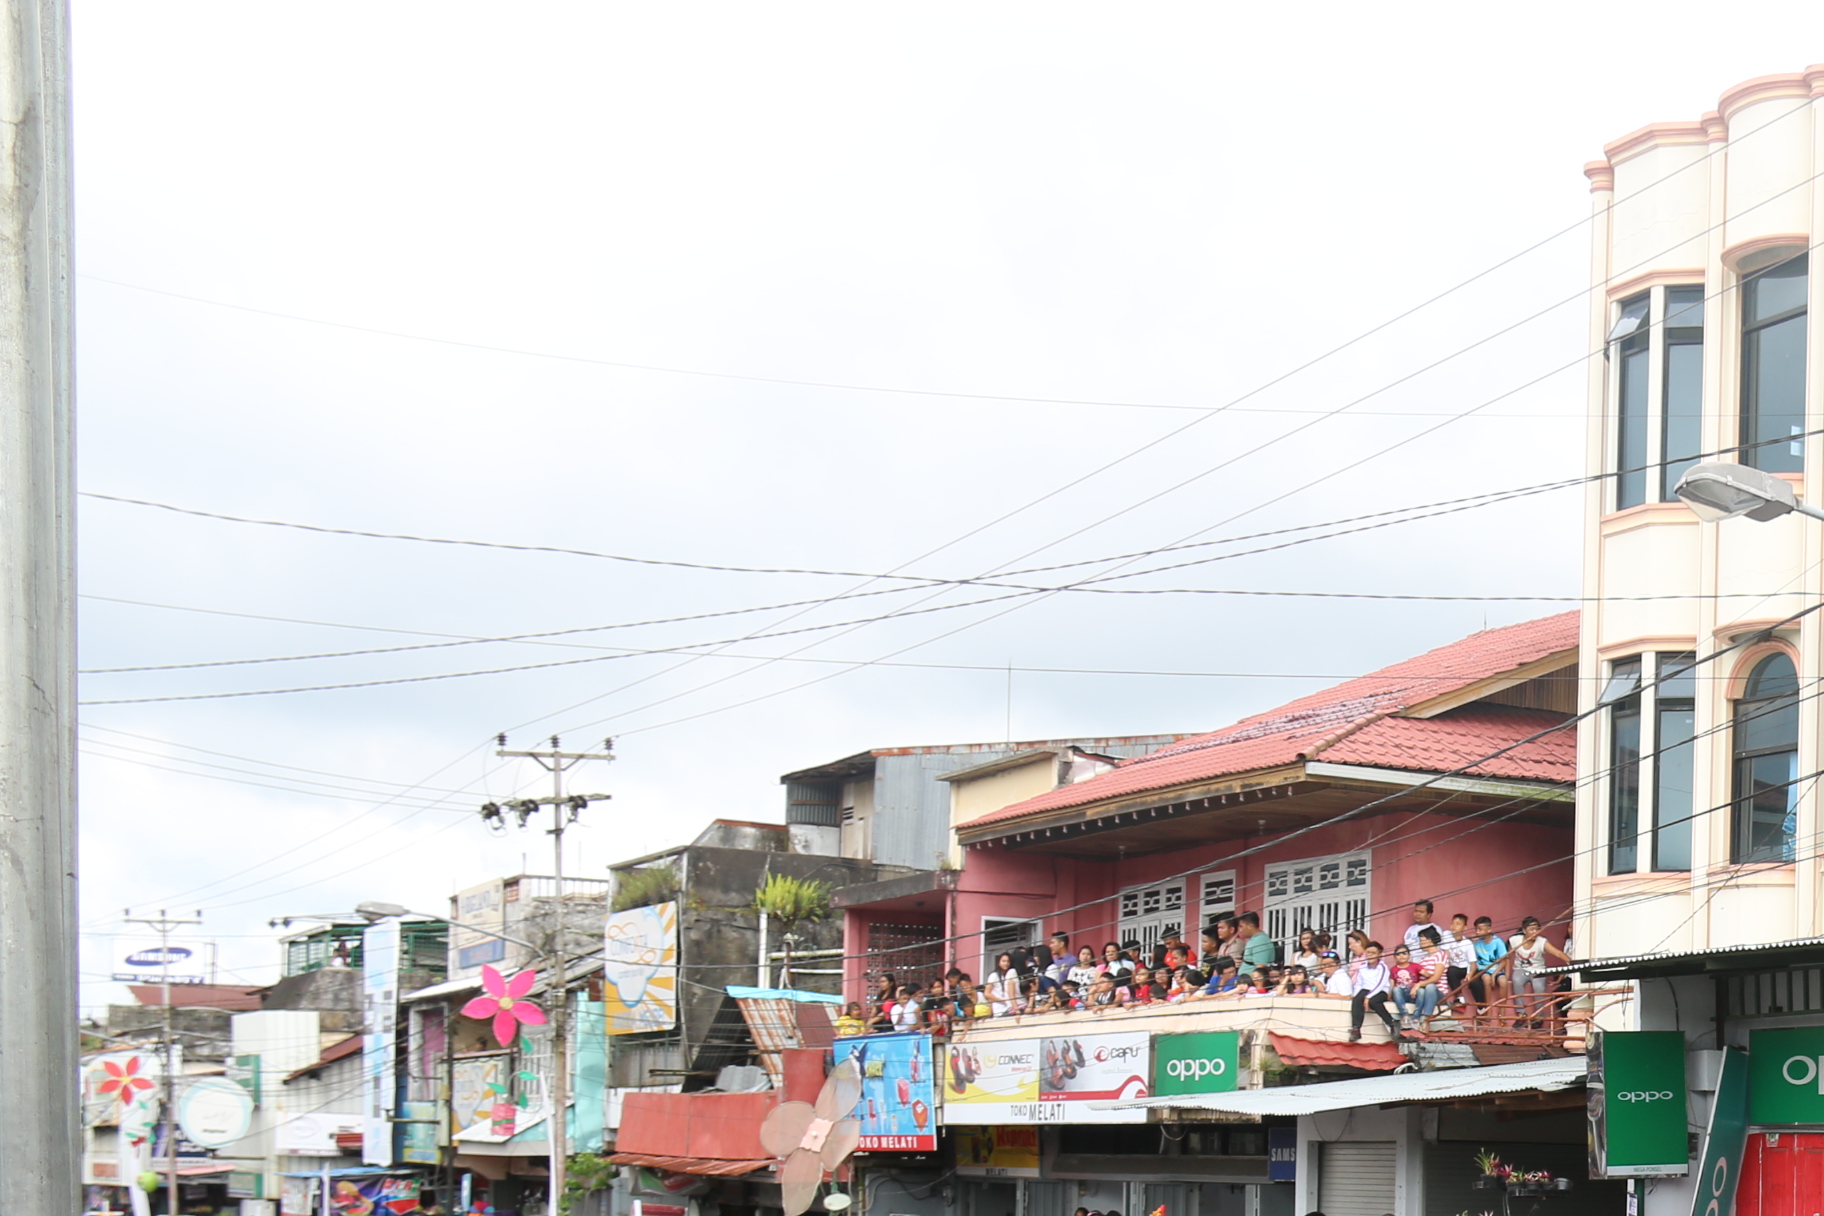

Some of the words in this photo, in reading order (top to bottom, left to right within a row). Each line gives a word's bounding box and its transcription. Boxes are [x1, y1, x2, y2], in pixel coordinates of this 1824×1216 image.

[1166, 1058, 1226, 1081] oppo
[1617, 1090, 1674, 1103] oppo
[1010, 1105, 1027, 1117] TOKO
[1028, 1103, 1066, 1122] MELATI
[860, 1136, 879, 1149] OKO
[881, 1136, 918, 1149] MELATI
